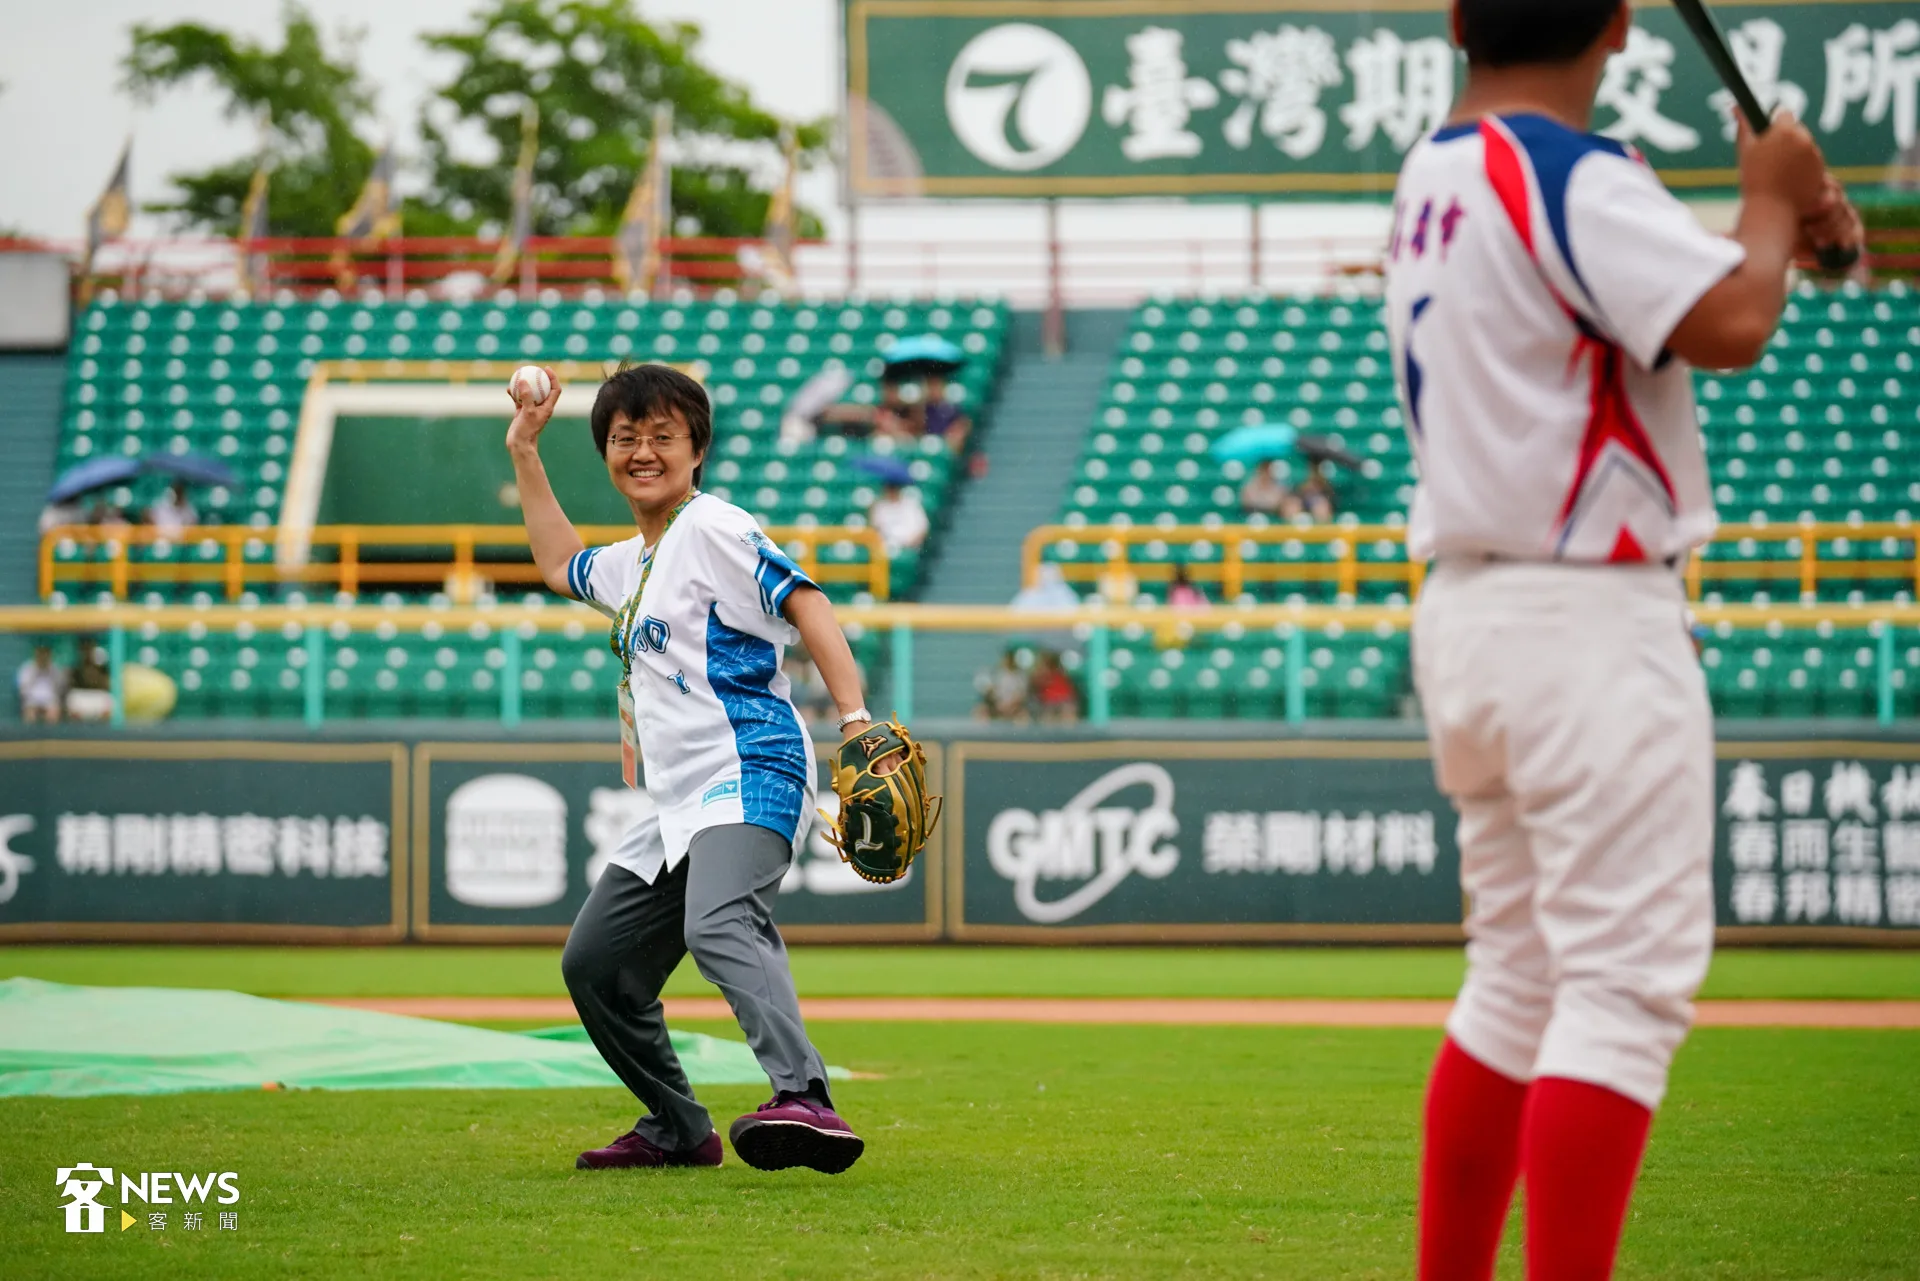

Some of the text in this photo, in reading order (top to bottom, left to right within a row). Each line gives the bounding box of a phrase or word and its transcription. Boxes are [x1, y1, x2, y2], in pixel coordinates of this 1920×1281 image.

[1101, 18, 1920, 160] 臺灣期交易所
[986, 807, 1181, 879] GMTC
